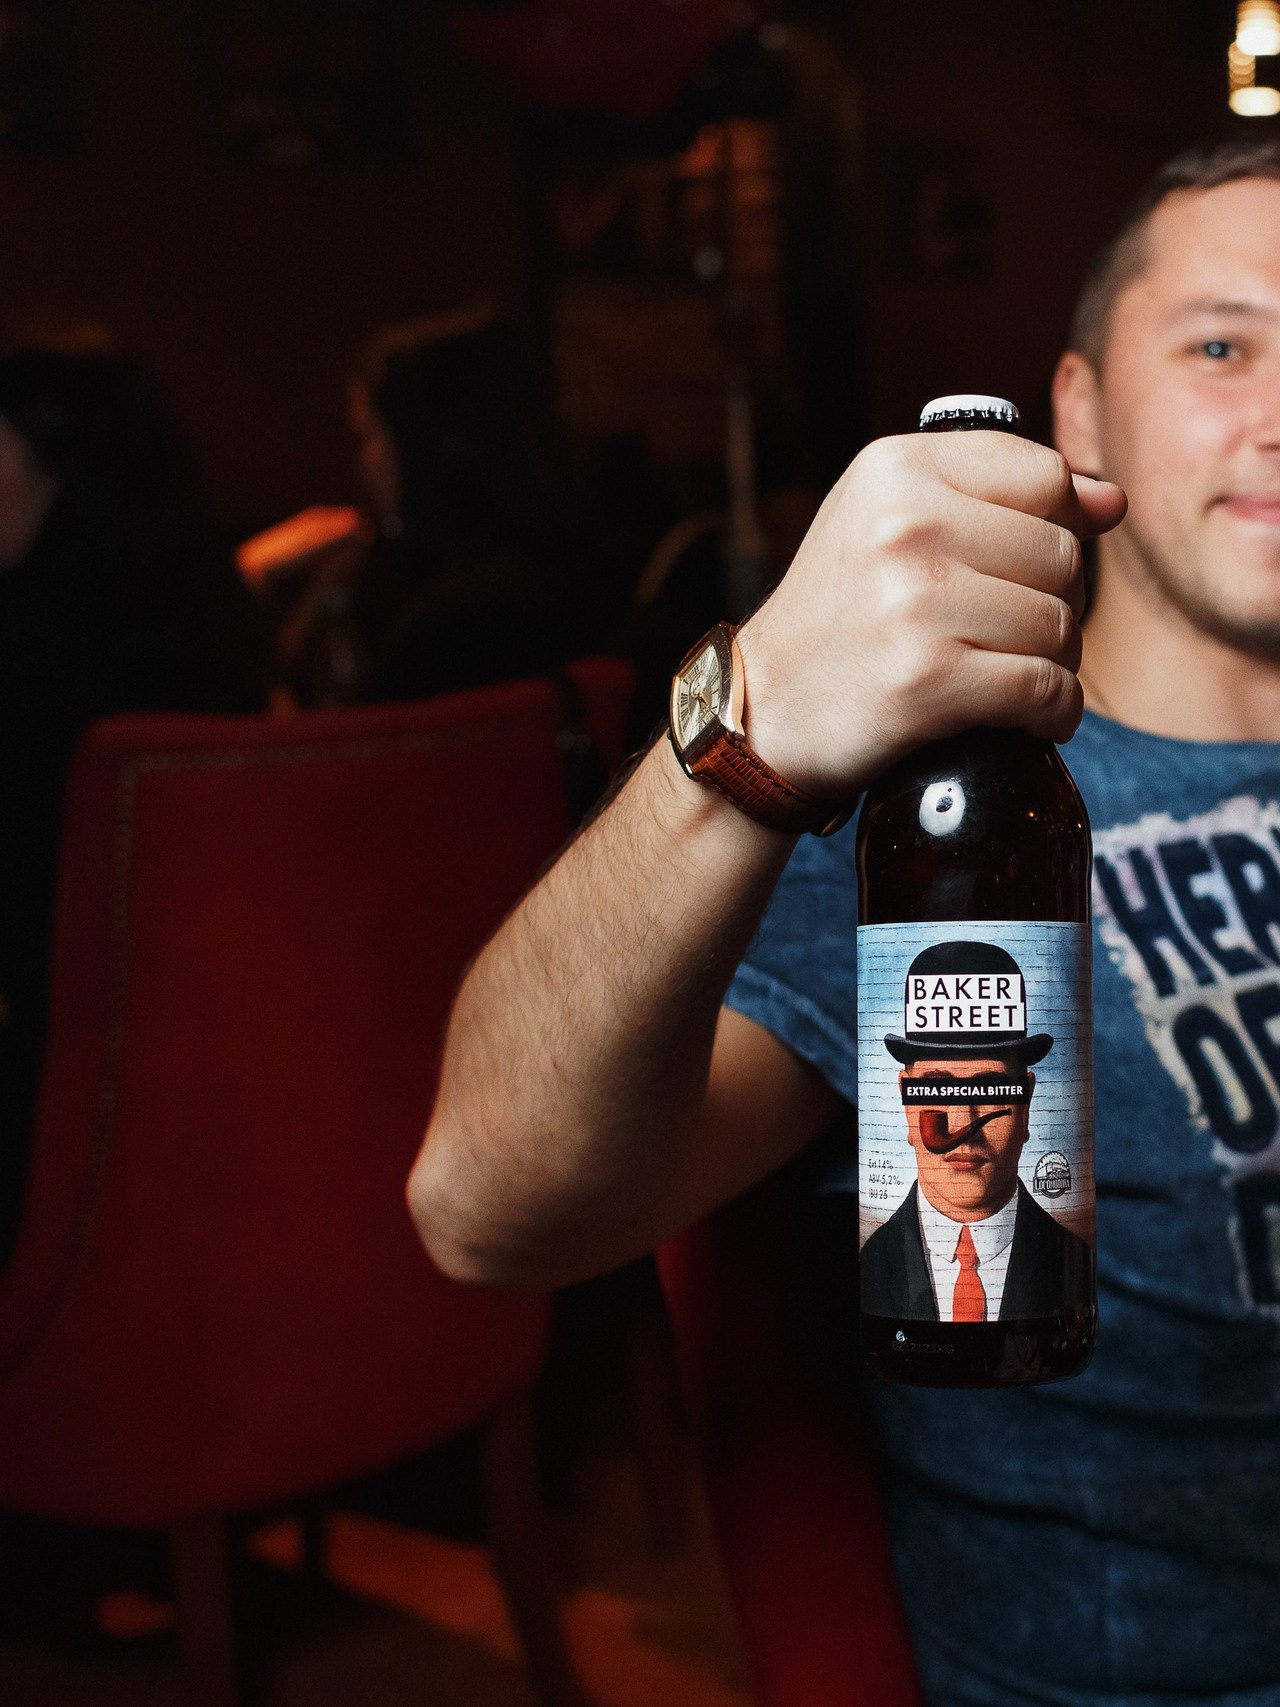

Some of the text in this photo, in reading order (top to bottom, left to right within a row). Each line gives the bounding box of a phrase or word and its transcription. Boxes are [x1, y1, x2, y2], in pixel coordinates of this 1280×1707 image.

[914, 977, 1012, 1000] BAKER
[914, 1004, 1018, 1029] STREET
[906, 1085, 1023, 1097] EXTRA SPECIAL BITTER
